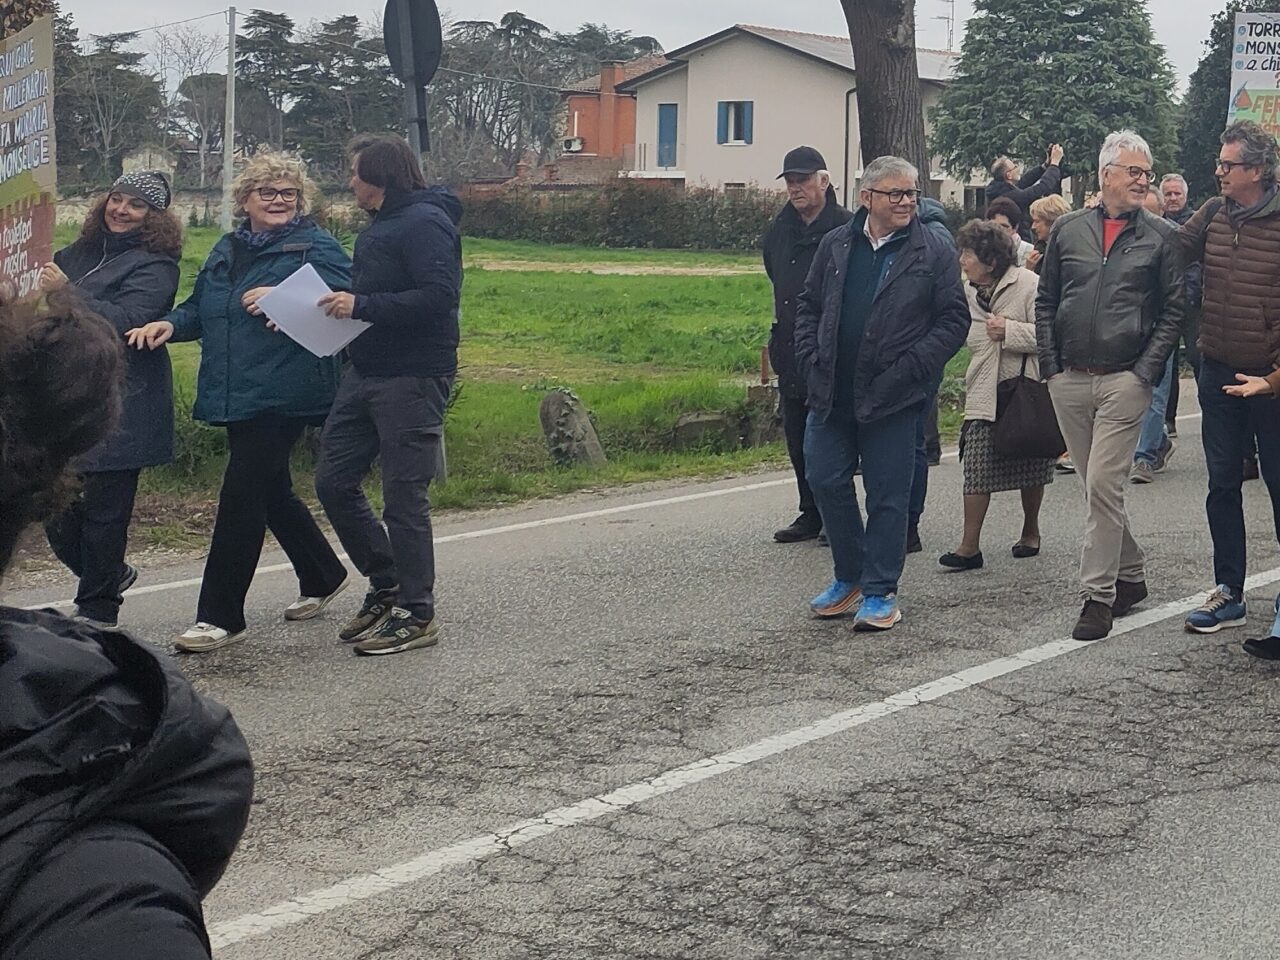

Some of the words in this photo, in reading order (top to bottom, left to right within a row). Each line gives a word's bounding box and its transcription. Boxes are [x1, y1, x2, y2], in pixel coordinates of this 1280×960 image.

[1245, 59, 1257, 71] a
[1261, 56, 1280, 71] chi
[3, 68, 49, 112] MILLENARIA
